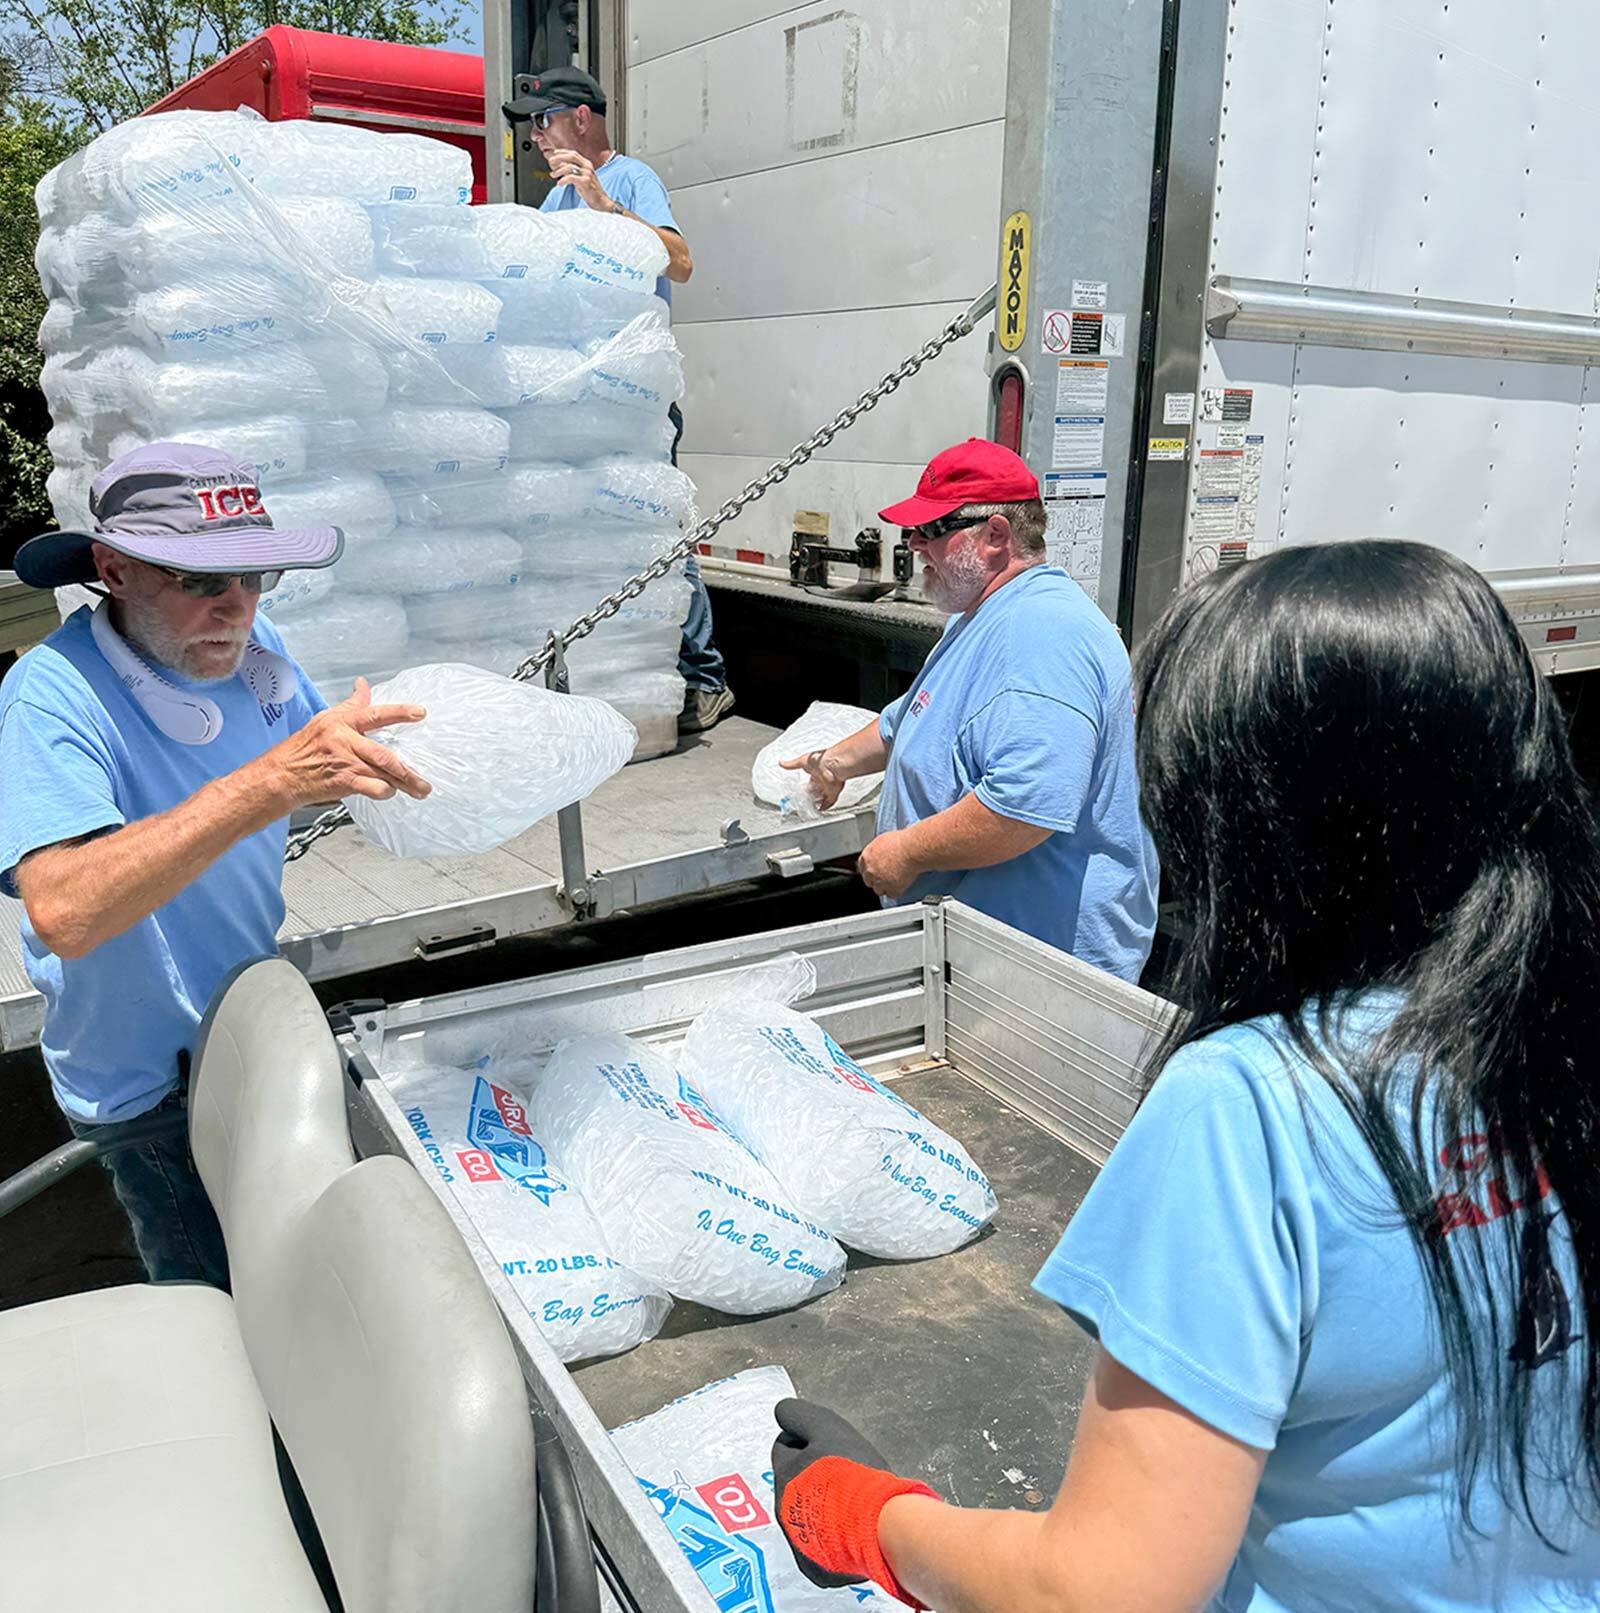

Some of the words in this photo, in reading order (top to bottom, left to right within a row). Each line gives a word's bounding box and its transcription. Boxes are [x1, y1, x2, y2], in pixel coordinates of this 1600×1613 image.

[1007, 227, 1024, 334] MAXON
[196, 485, 266, 520] ICE
[919, 1139, 936, 1157] 20
[938, 1149, 965, 1175] LBS.
[910, 1176, 938, 1204] Bag
[752, 1195, 770, 1212] 20
[773, 1204, 804, 1227] LBS.
[696, 1209, 712, 1231] Is
[715, 1218, 747, 1247] One
[750, 1232, 782, 1266] Bag
[536, 1257, 558, 1274] 20
[562, 1254, 603, 1272] LBS.
[543, 1300, 584, 1326] Bag
[714, 1479, 757, 1525] CO.
